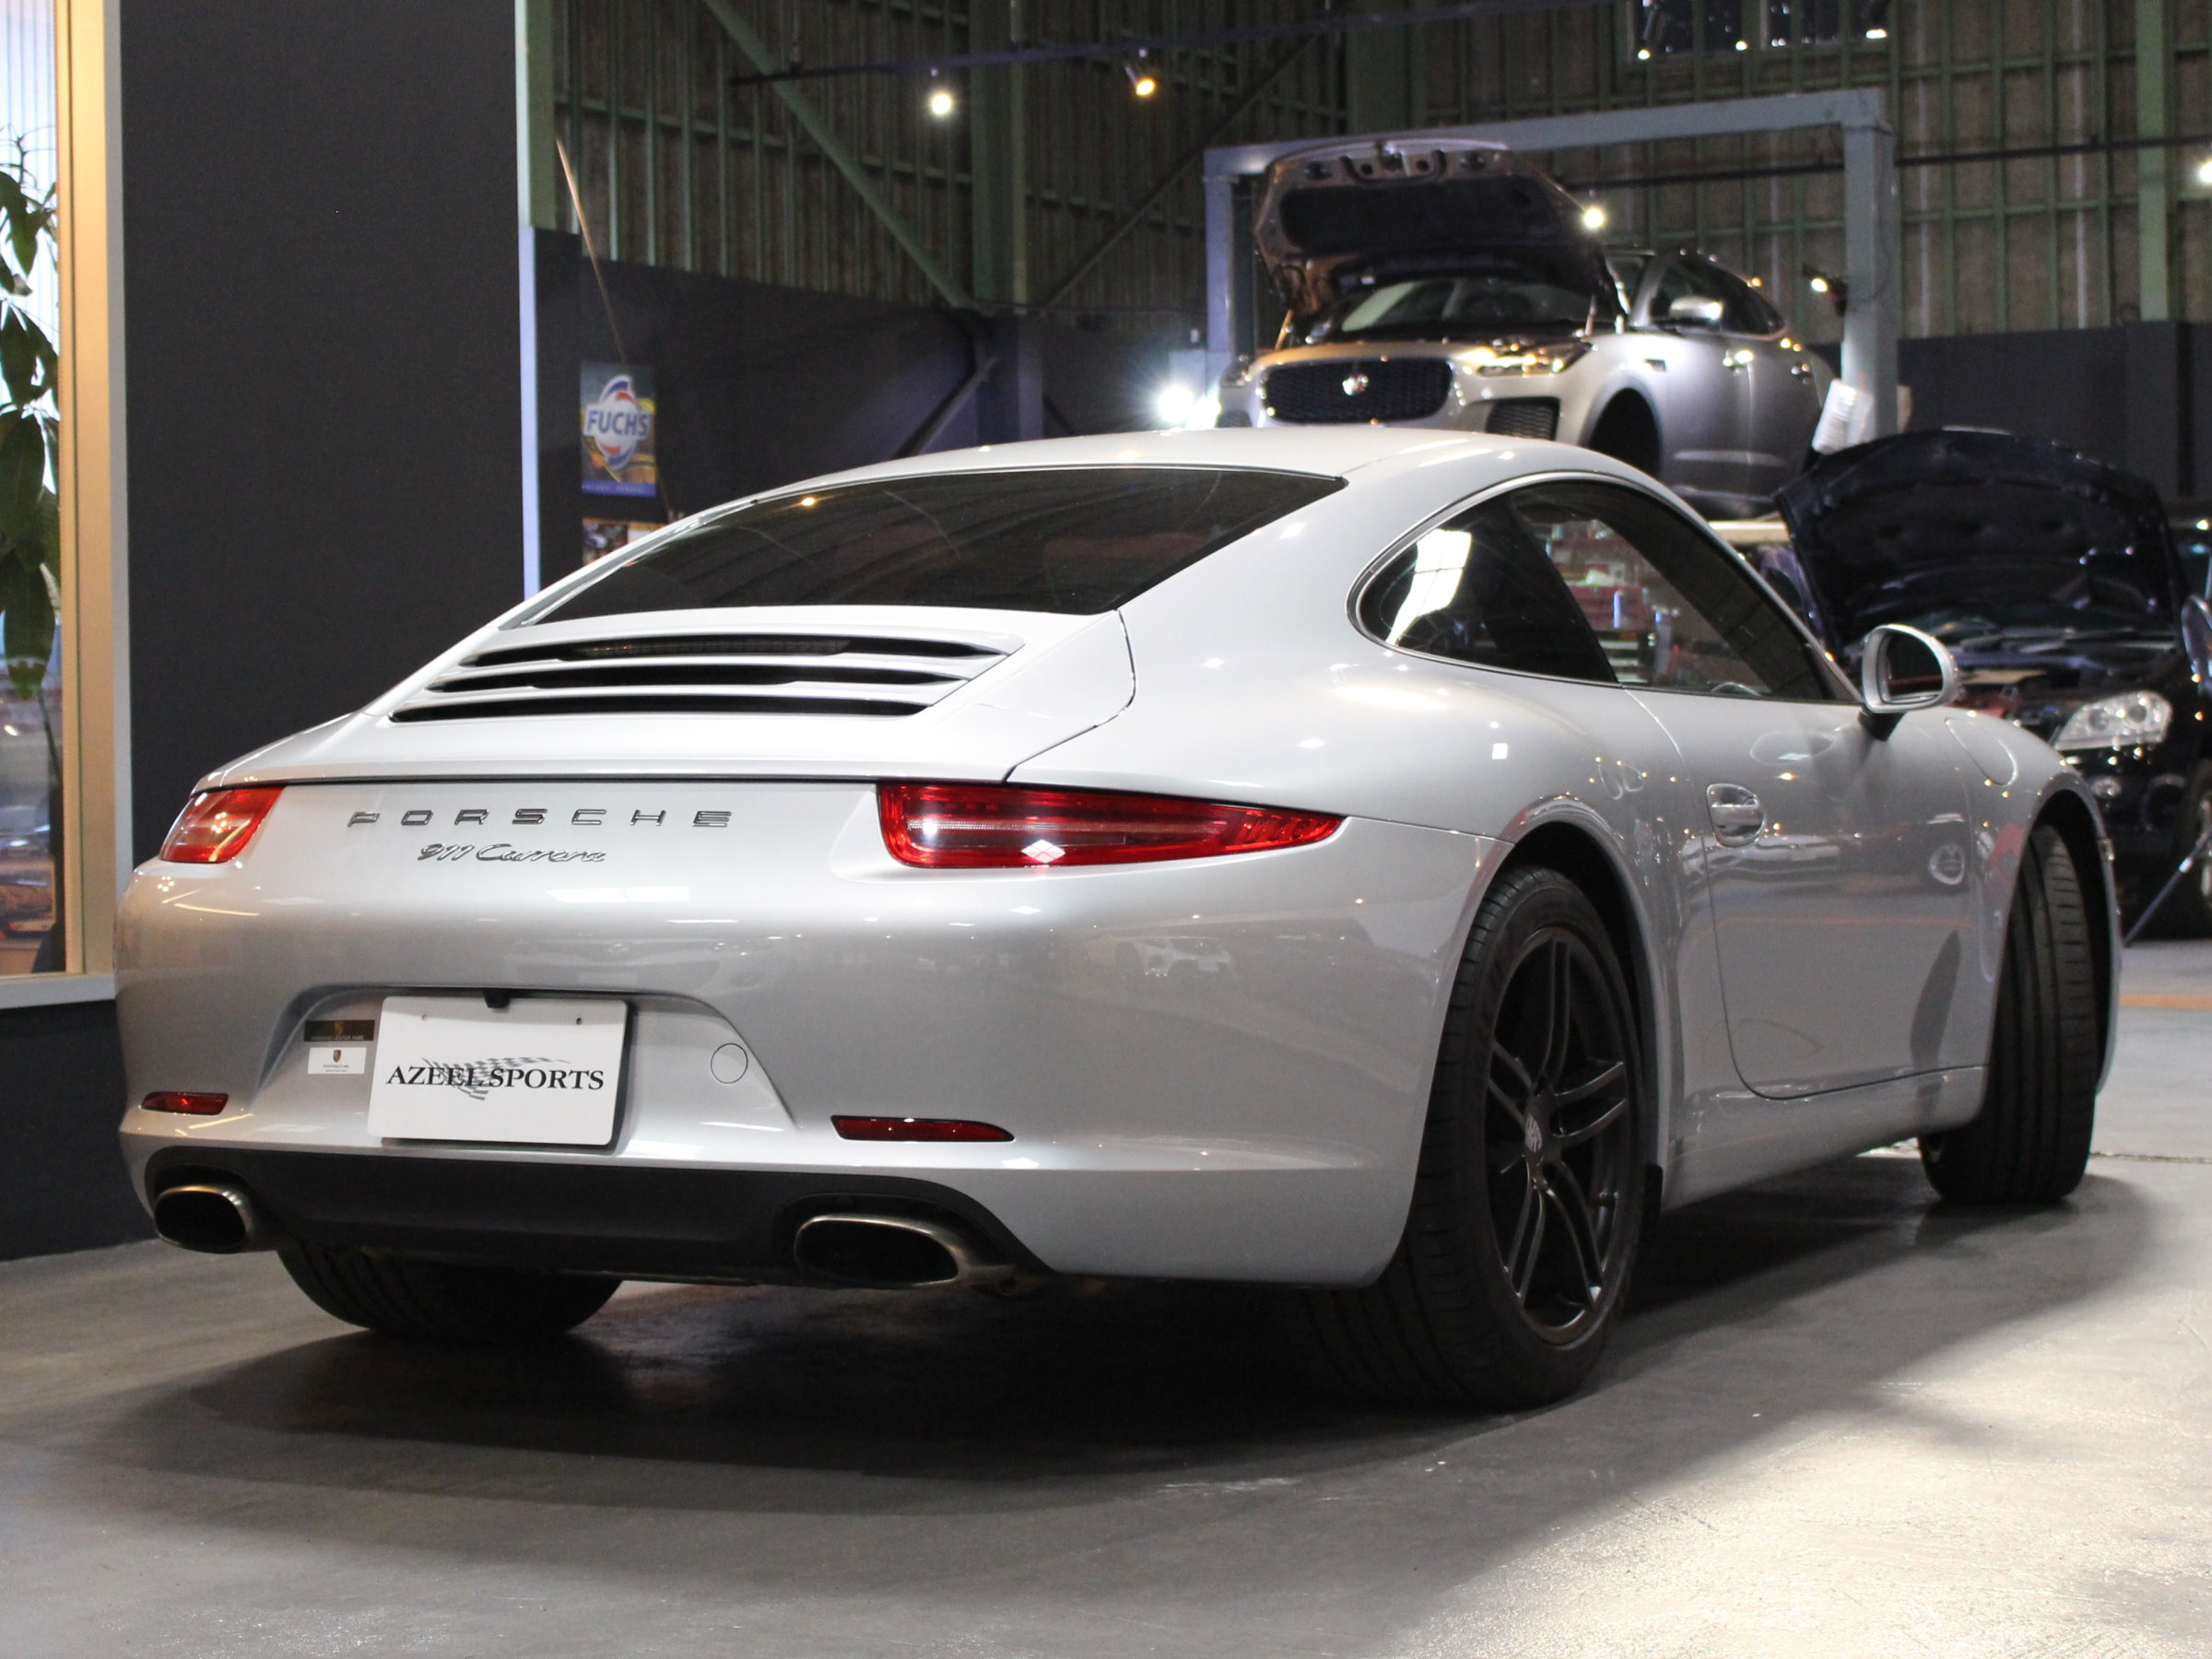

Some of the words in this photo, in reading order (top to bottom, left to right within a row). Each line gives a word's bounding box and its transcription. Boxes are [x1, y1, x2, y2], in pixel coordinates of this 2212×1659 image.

[587, 410, 649, 436] FUCHS
[347, 808, 733, 829] PORSCHE
[417, 844, 472, 862] 911
[476, 843, 606, 863] Carrera
[385, 1065, 484, 1087] AZEEL
[488, 1067, 605, 1090] SPORTS
